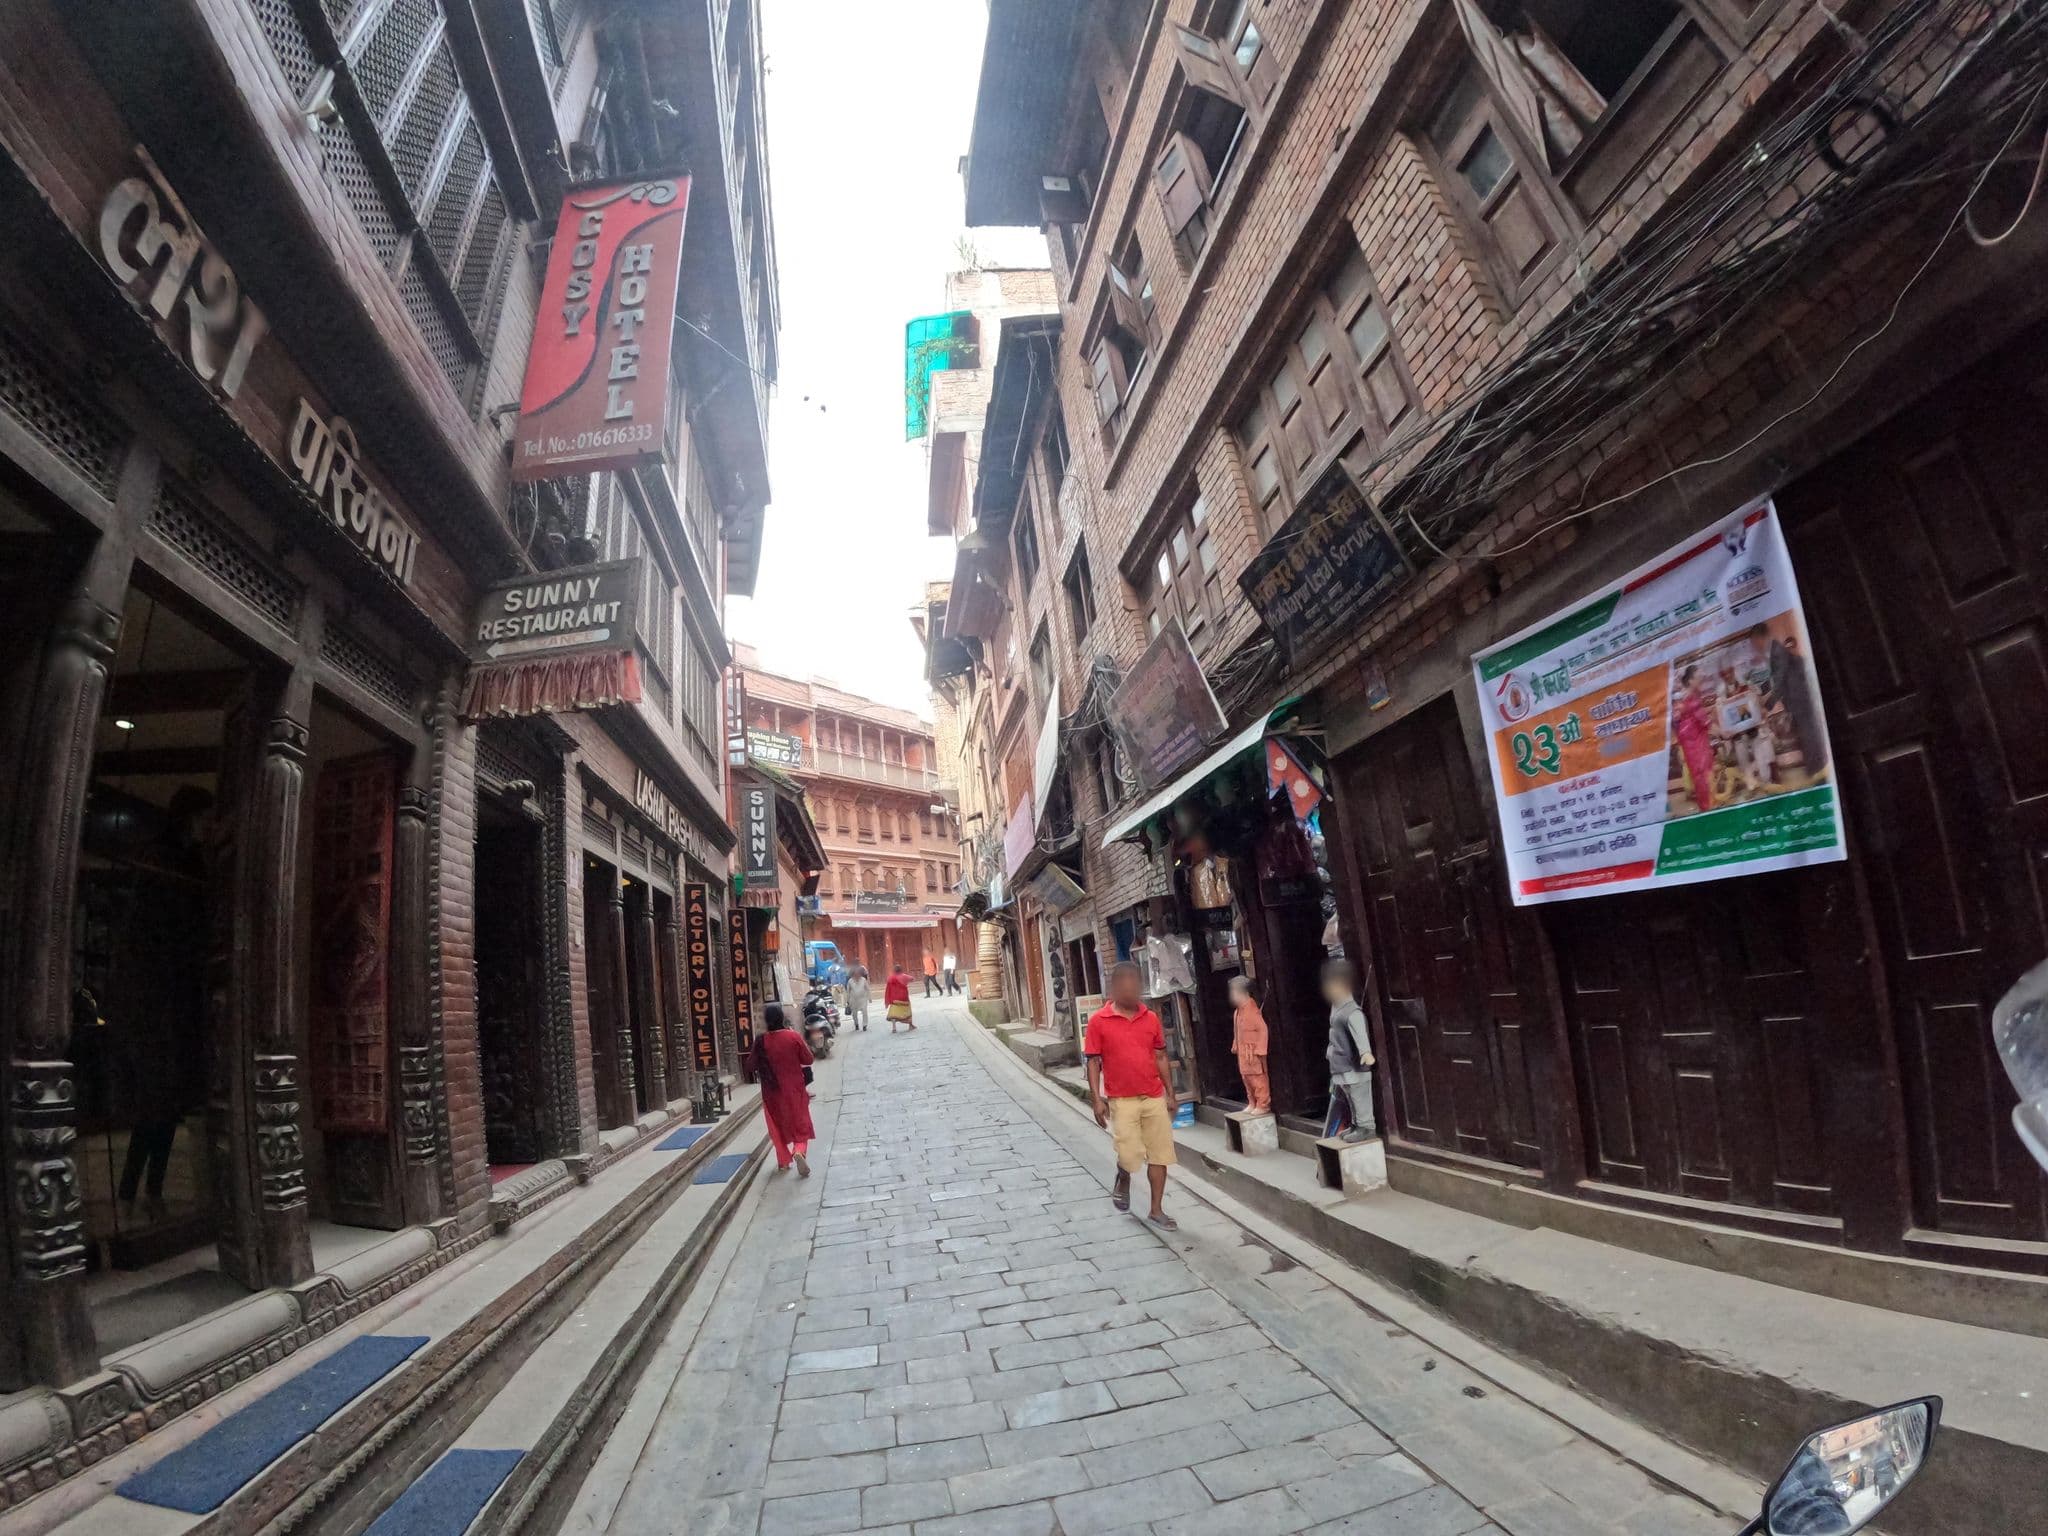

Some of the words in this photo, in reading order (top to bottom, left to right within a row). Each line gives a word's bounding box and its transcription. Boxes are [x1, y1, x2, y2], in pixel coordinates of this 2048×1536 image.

[562, 211, 604, 337] COSY
[604, 243, 654, 421] HOTEL
[523, 439, 544, 457] Tel.
[477, 601, 622, 641] RESTAURANT
[503, 576, 601, 613] SUNNY
[636, 767, 667, 831] LASHA
[750, 790, 767, 867] SUNNY
[689, 889, 706, 980] FACTORY
[693, 988, 713, 1067] OUTLET
